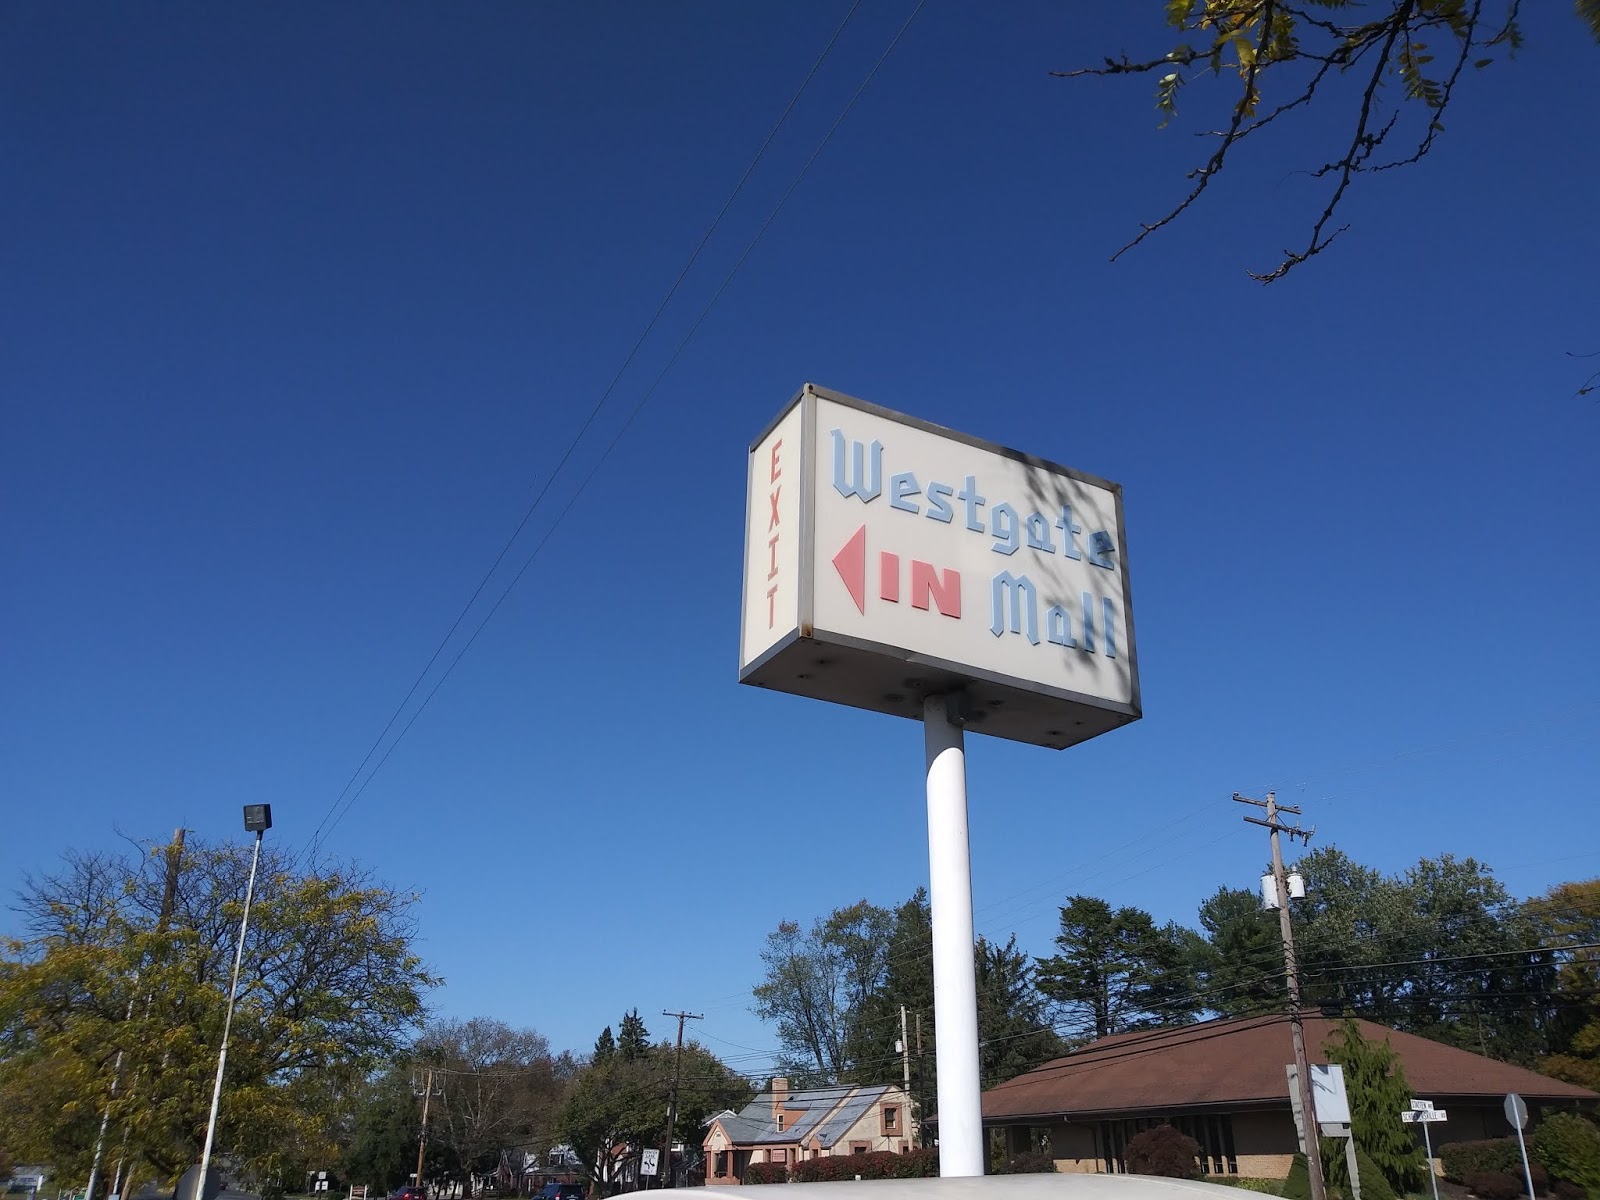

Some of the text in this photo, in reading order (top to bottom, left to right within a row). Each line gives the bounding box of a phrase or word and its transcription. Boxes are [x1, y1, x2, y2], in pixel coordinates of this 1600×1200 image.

[767, 438, 783, 630] EXIT
[830, 427, 1115, 571] Westgate
[880, 550, 961, 619] IN
[989, 569, 1116, 659] Mall
